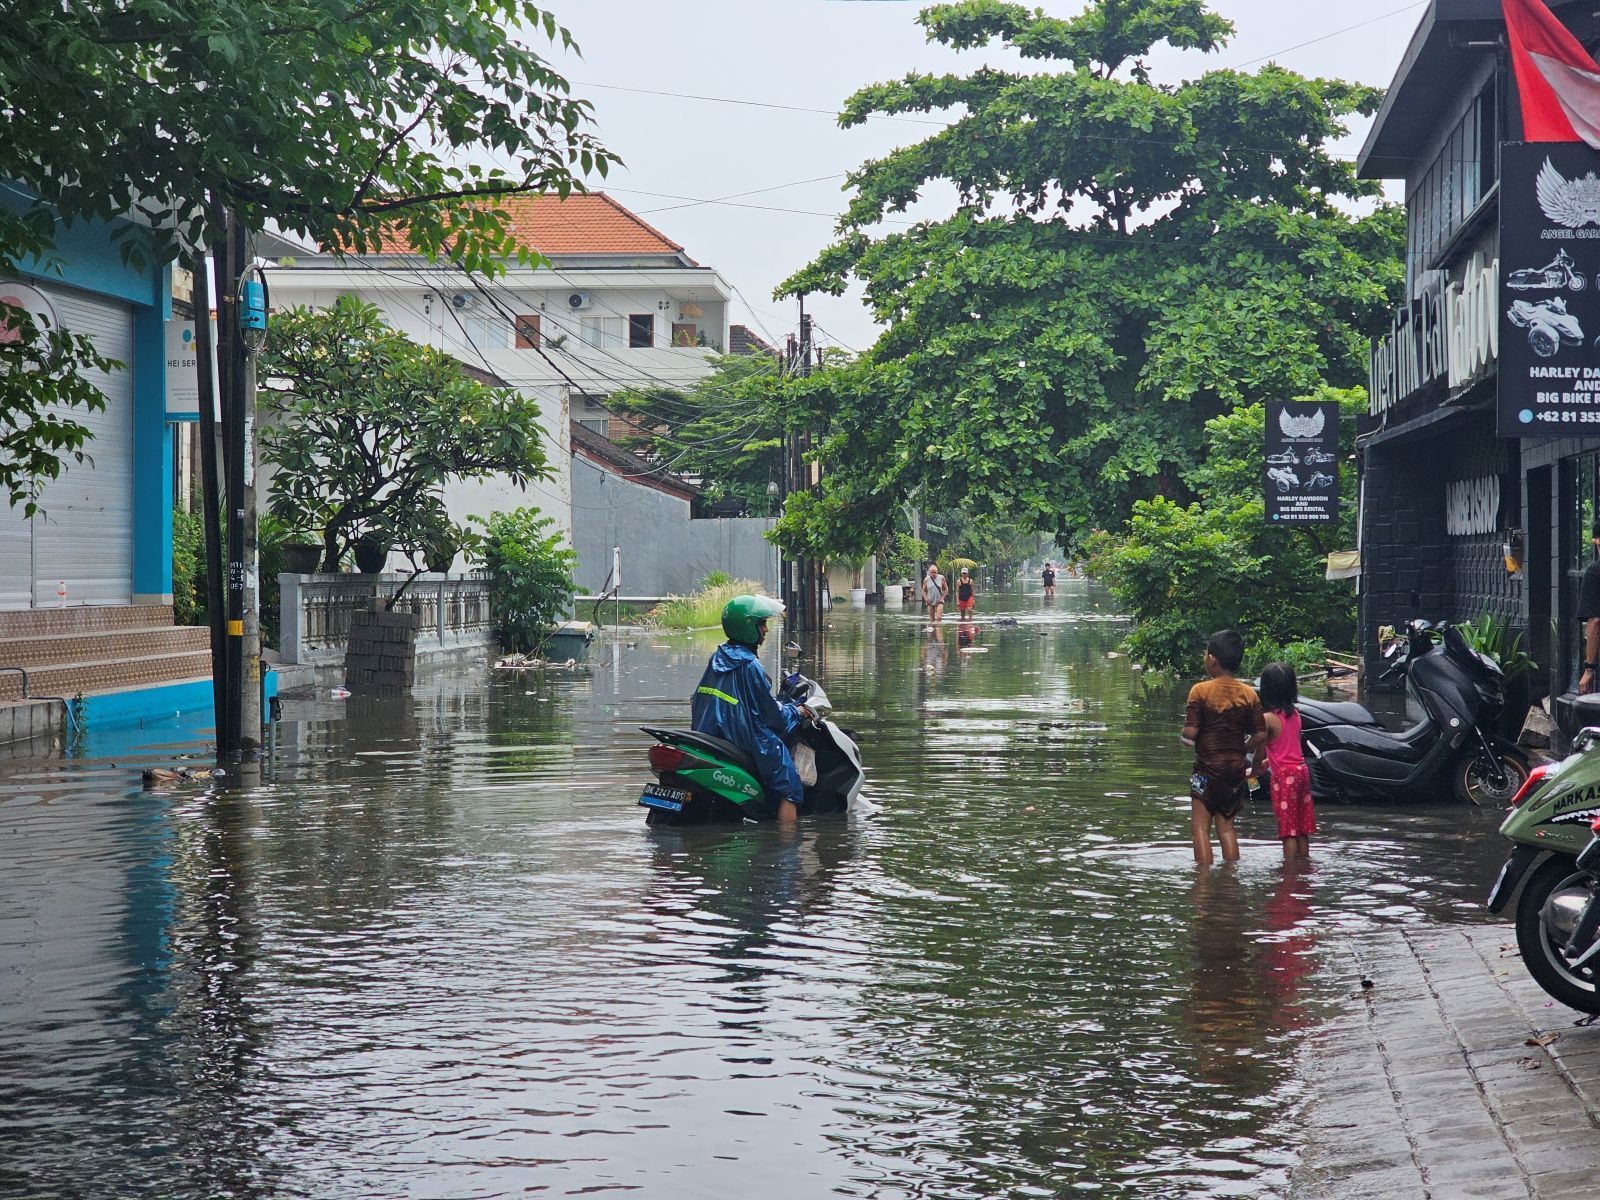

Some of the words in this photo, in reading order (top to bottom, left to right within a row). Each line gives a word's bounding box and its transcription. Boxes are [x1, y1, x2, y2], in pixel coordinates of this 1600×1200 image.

[1541, 229, 1575, 239] ANGEL
[167, 359, 180, 368] HEI
[1529, 366, 1581, 378] HARLEY
[1536, 392, 1559, 403] BIG
[1562, 392, 1591, 404] BIKE
[1536, 411, 1559, 422] +62
[1561, 411, 1577, 422] 81
[713, 770, 736, 787] Grab
